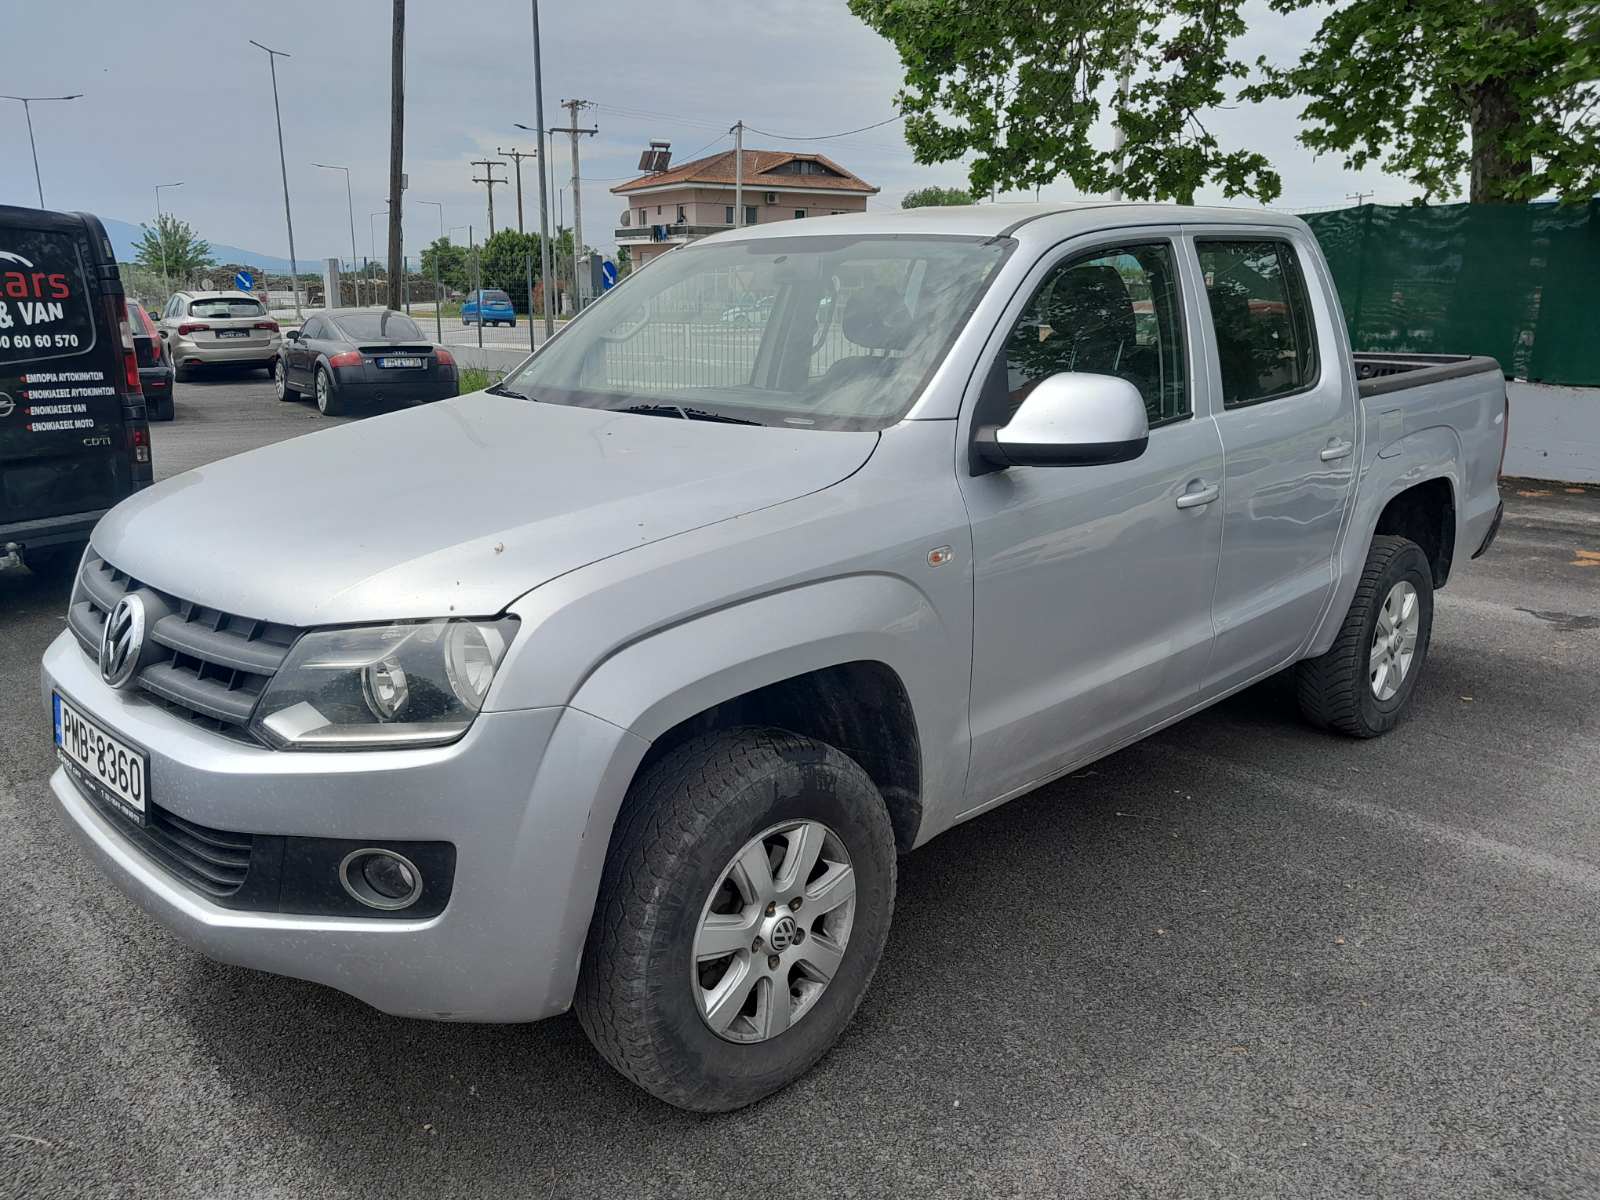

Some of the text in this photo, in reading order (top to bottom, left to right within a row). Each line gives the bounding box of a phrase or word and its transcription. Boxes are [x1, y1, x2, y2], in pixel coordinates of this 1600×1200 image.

[0, 271, 70, 299] ars
[17, 301, 64, 326] VAN
[0, 334, 79, 348] 0 60 60 570
[26, 371, 104, 383] ΕΜΠΟΡΙΑ ΑΥΤΟΚΙΝΗΤΩΝ
[28, 387, 115, 400] ΕΝΟΙΚΙΑΣΕΙΣ ΑΥΤΟΚΙΝΗΤΩΝ
[30, 403, 87, 415] ΕΝΟΙΚΙΑΣΕΙΣ VAN
[32, 420, 74, 431] ΕΝΟΙΚΙΑΣΕΙΣ
